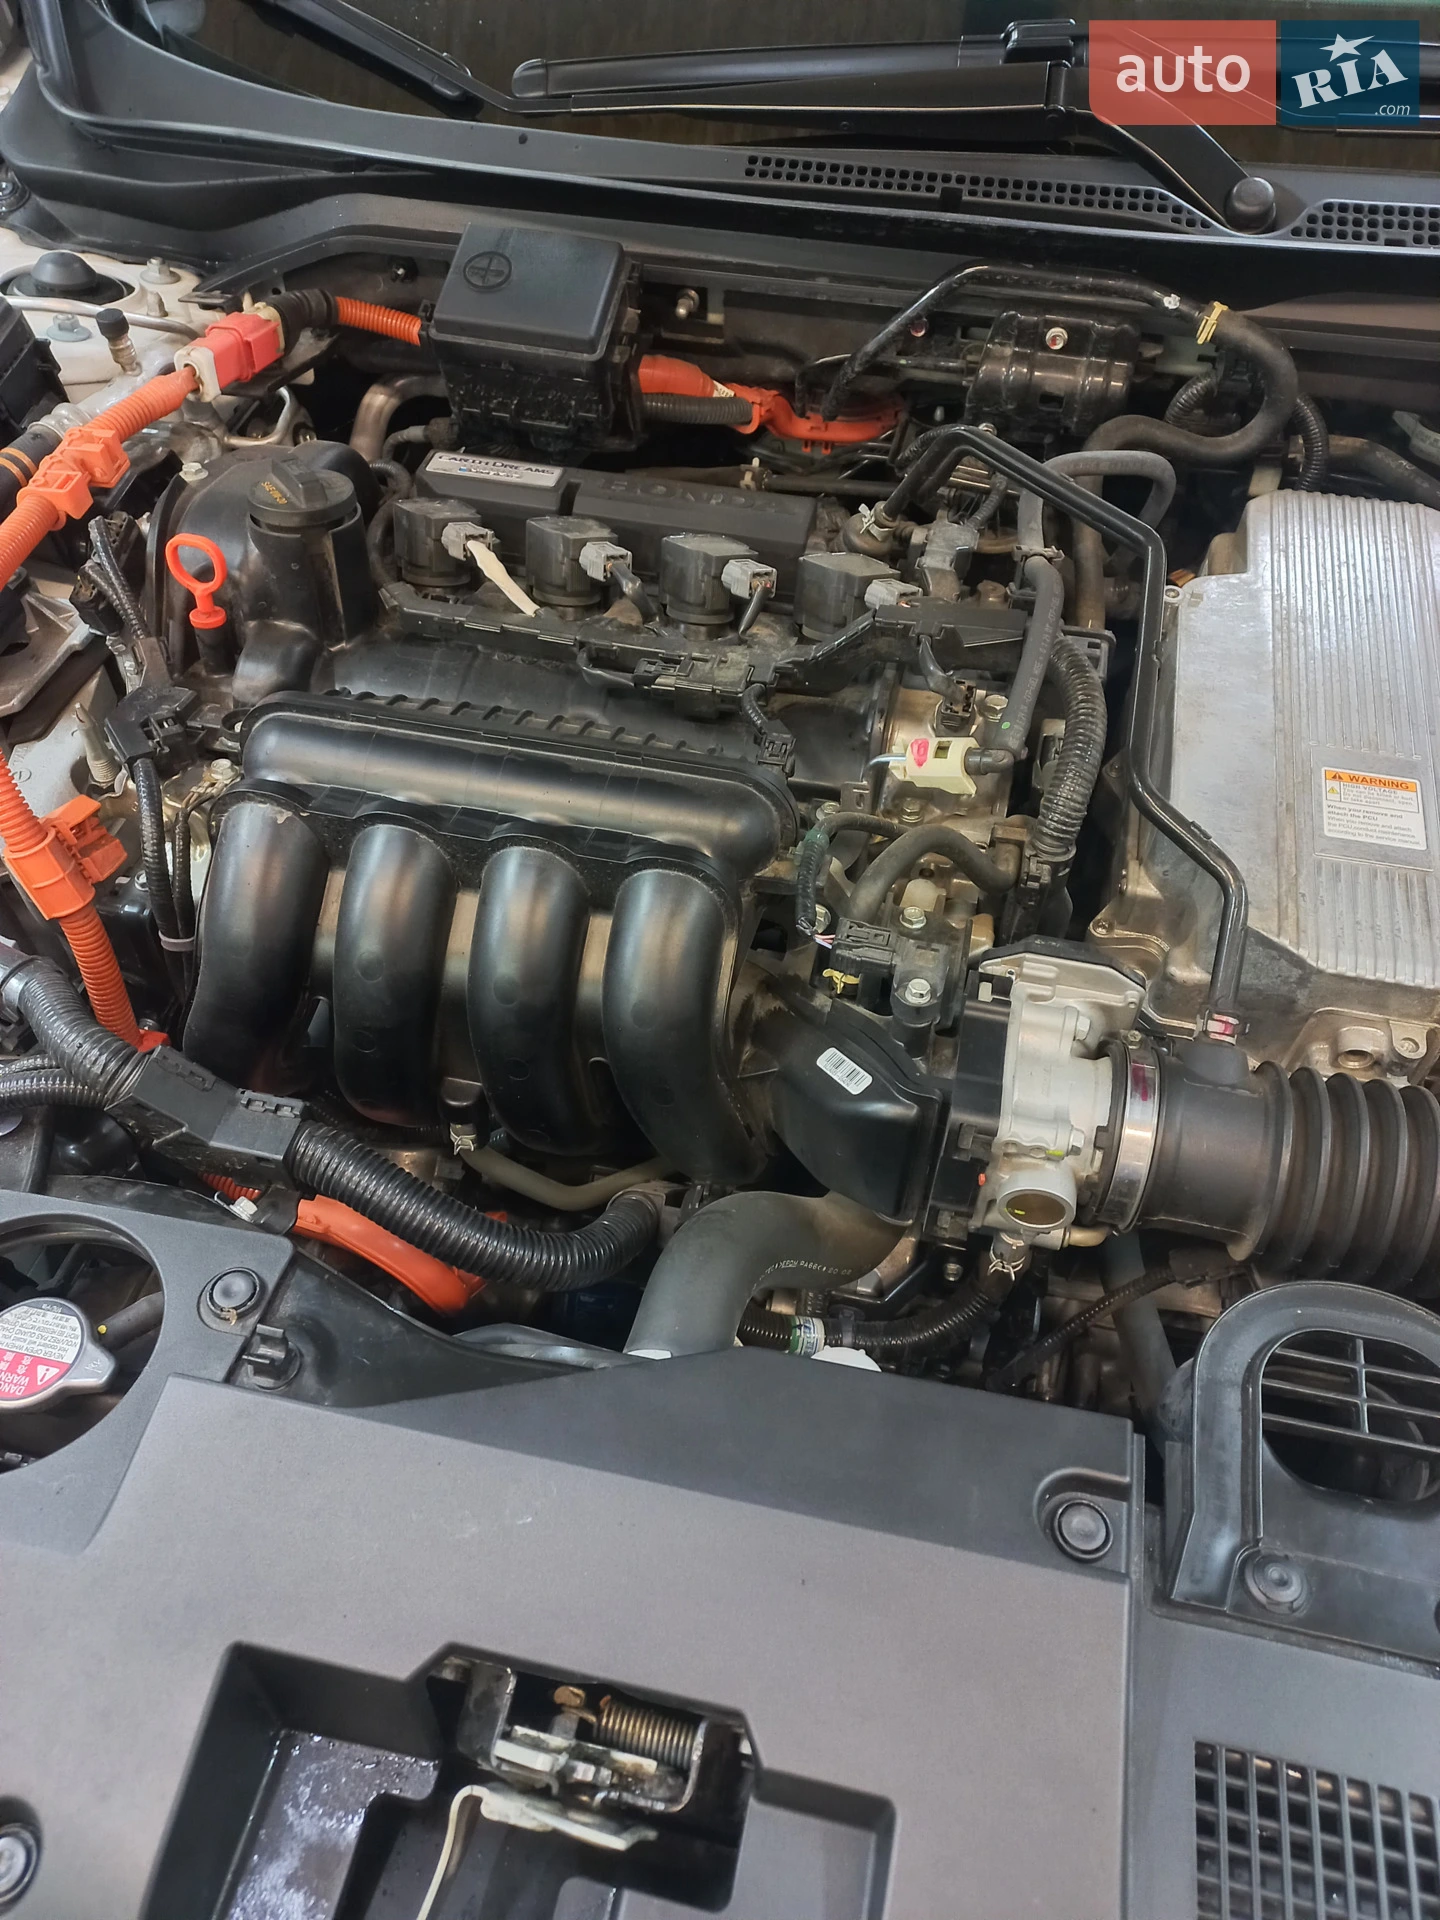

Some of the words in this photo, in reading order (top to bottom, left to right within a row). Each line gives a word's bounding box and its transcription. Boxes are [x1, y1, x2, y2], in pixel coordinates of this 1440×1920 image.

[1348, 774, 1409, 790] WARNING
[1342, 782, 1361, 790] HIGH
[1363, 785, 1397, 795] VOLTAGE
[25, 1345, 43, 1356] OPEN
[43, 1349, 66, 1360] NEVER
